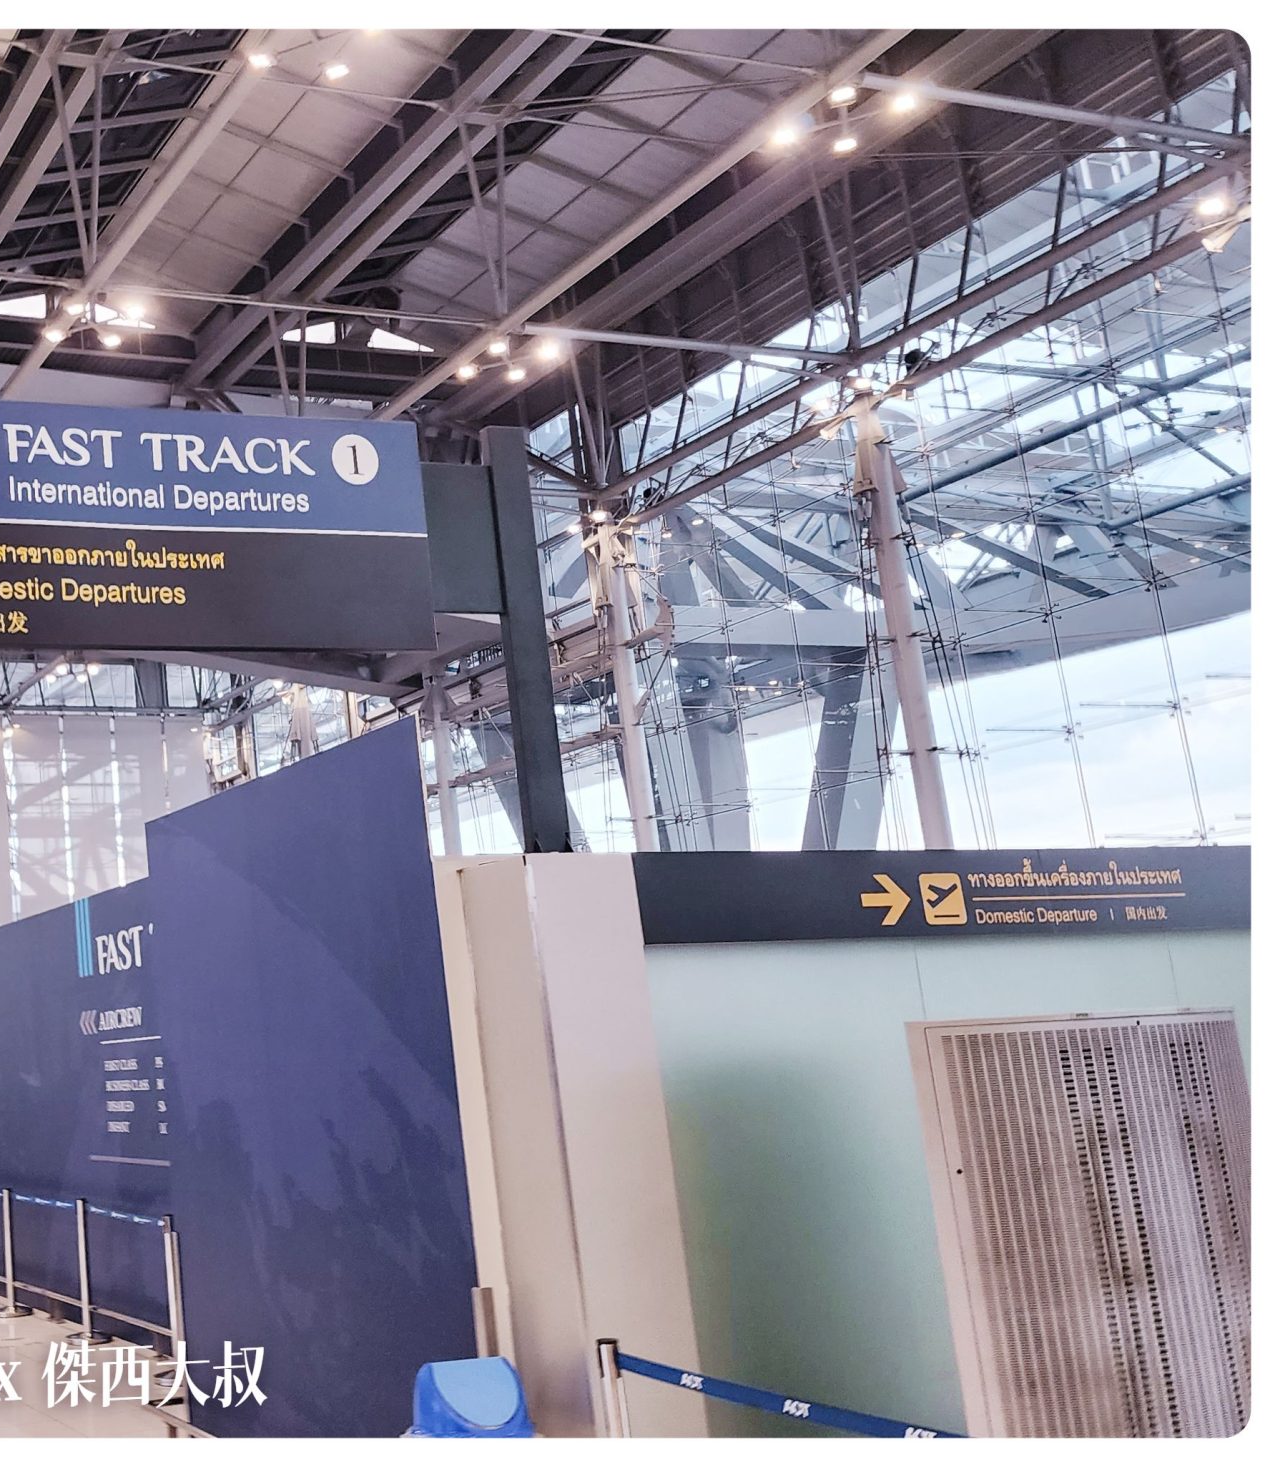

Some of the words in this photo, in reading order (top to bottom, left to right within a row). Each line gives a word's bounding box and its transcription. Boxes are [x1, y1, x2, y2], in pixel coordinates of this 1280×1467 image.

[2, 423, 123, 469] FAST
[140, 432, 316, 477] TRACK
[346, 445, 365, 476] 1
[8, 475, 165, 510] International
[173, 484, 311, 516] Departures
[60, 577, 187, 607] Departures
[967, 857, 1183, 888] ทางออกขึ้นเครื่องภายในประเทศ
[975, 907, 1035, 925] Domestic
[1036, 907, 1098, 926] Departure
[1125, 905, 1168, 921] 国内出发
[95, 925, 144, 976] FAST
